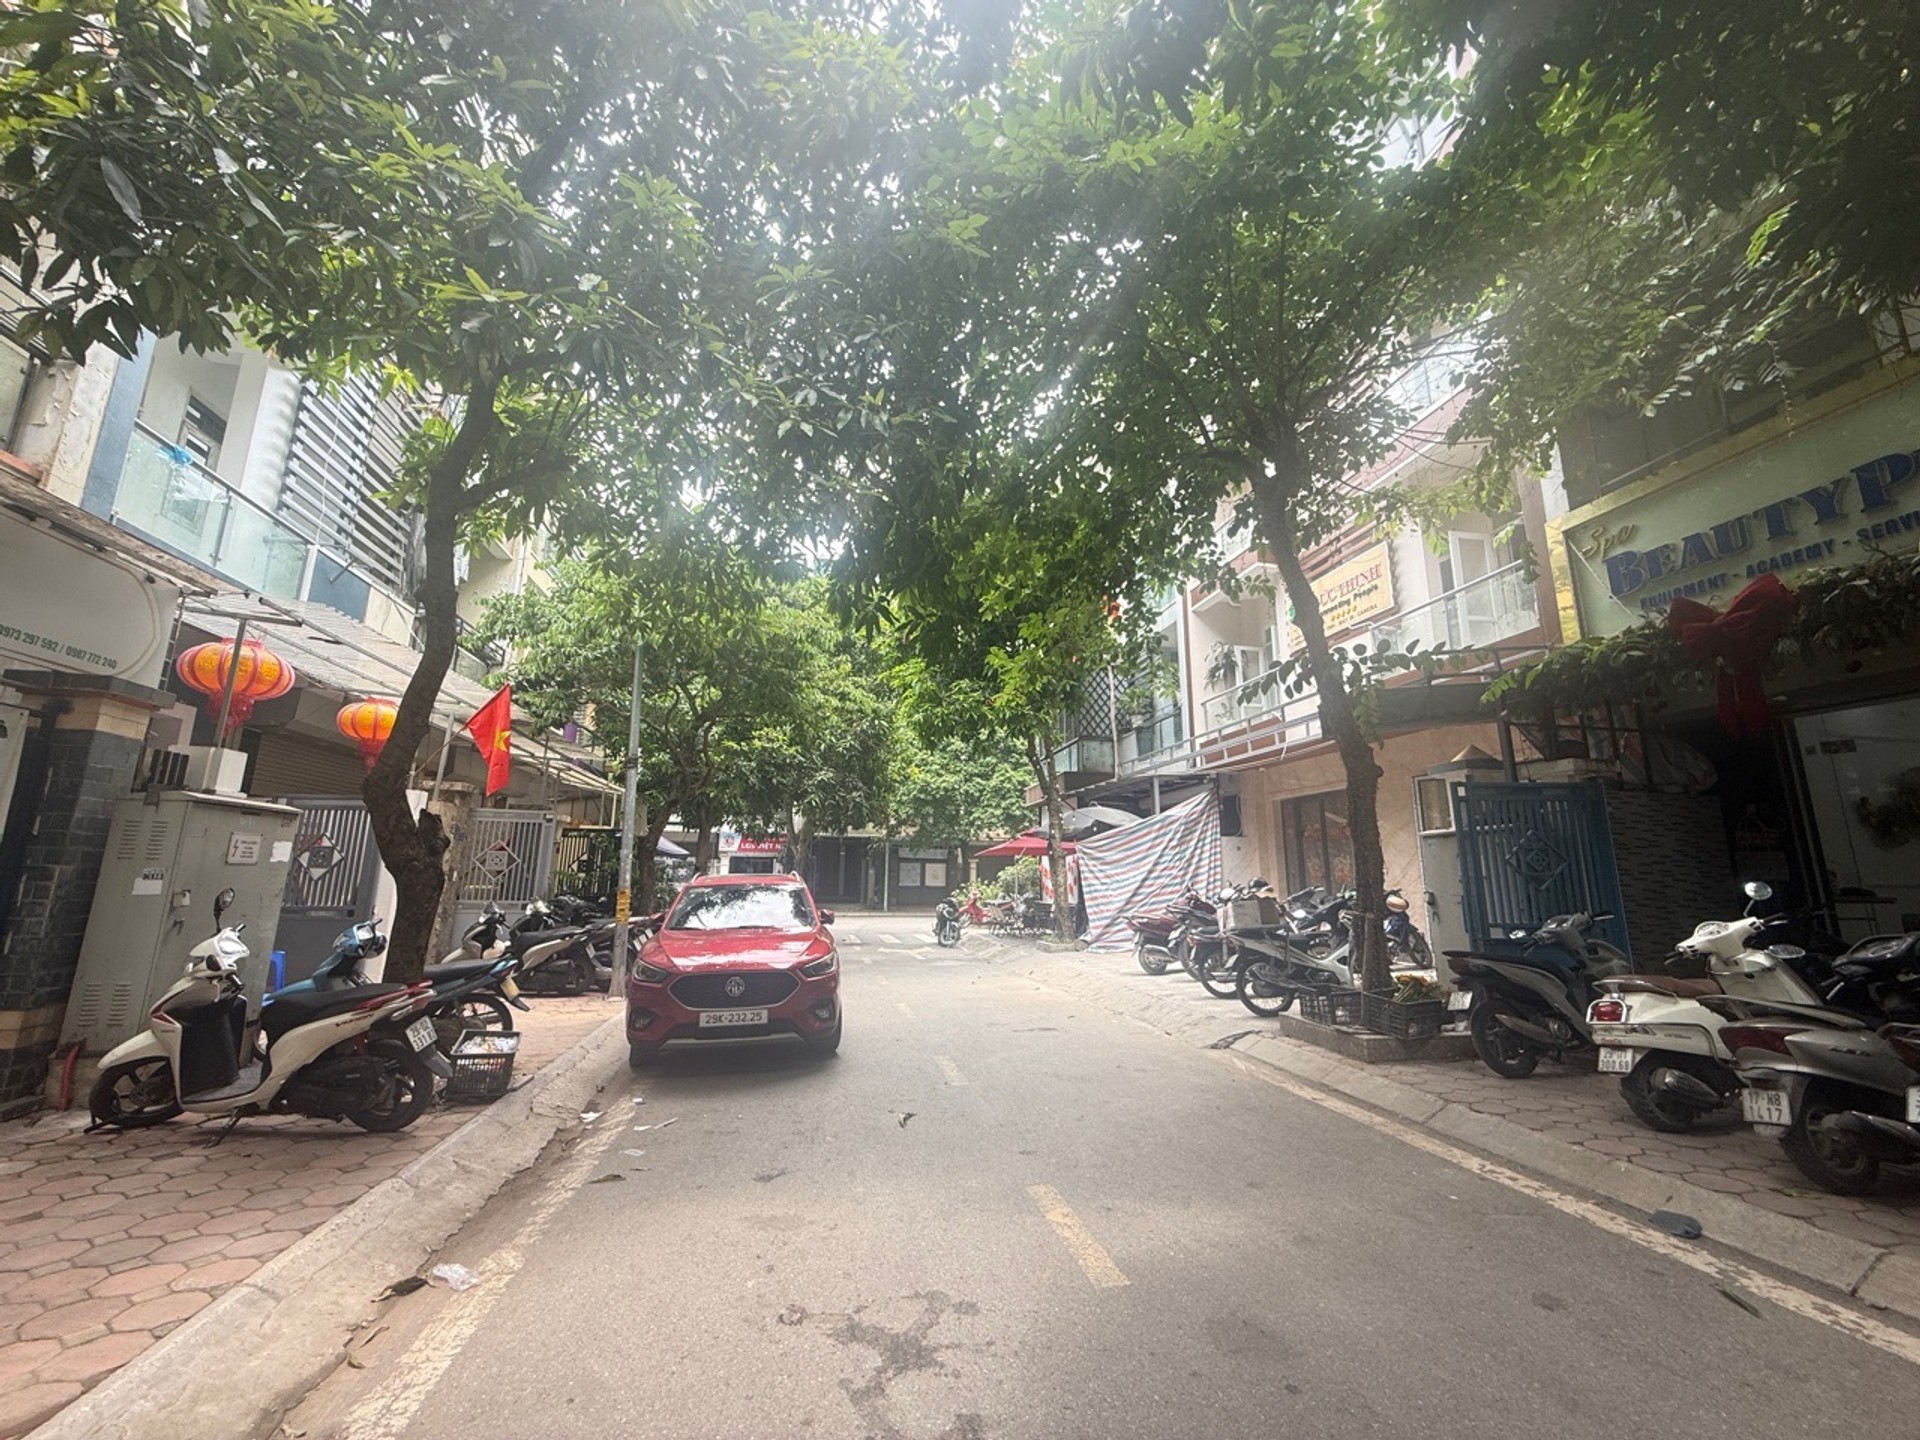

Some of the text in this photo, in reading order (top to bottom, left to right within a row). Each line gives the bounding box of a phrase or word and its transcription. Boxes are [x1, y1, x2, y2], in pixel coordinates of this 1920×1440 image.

[1603, 449, 1920, 600] BEAUTYP
[1581, 522, 1638, 559] Spa
[1745, 538, 1835, 579] ACADEMY
[22, 631, 41, 647] 297
[40, 637, 60, 653] 592
[704, 1011, 763, 1025] 29K-232.25
[1748, 1090, 1782, 1107] 17-N8
